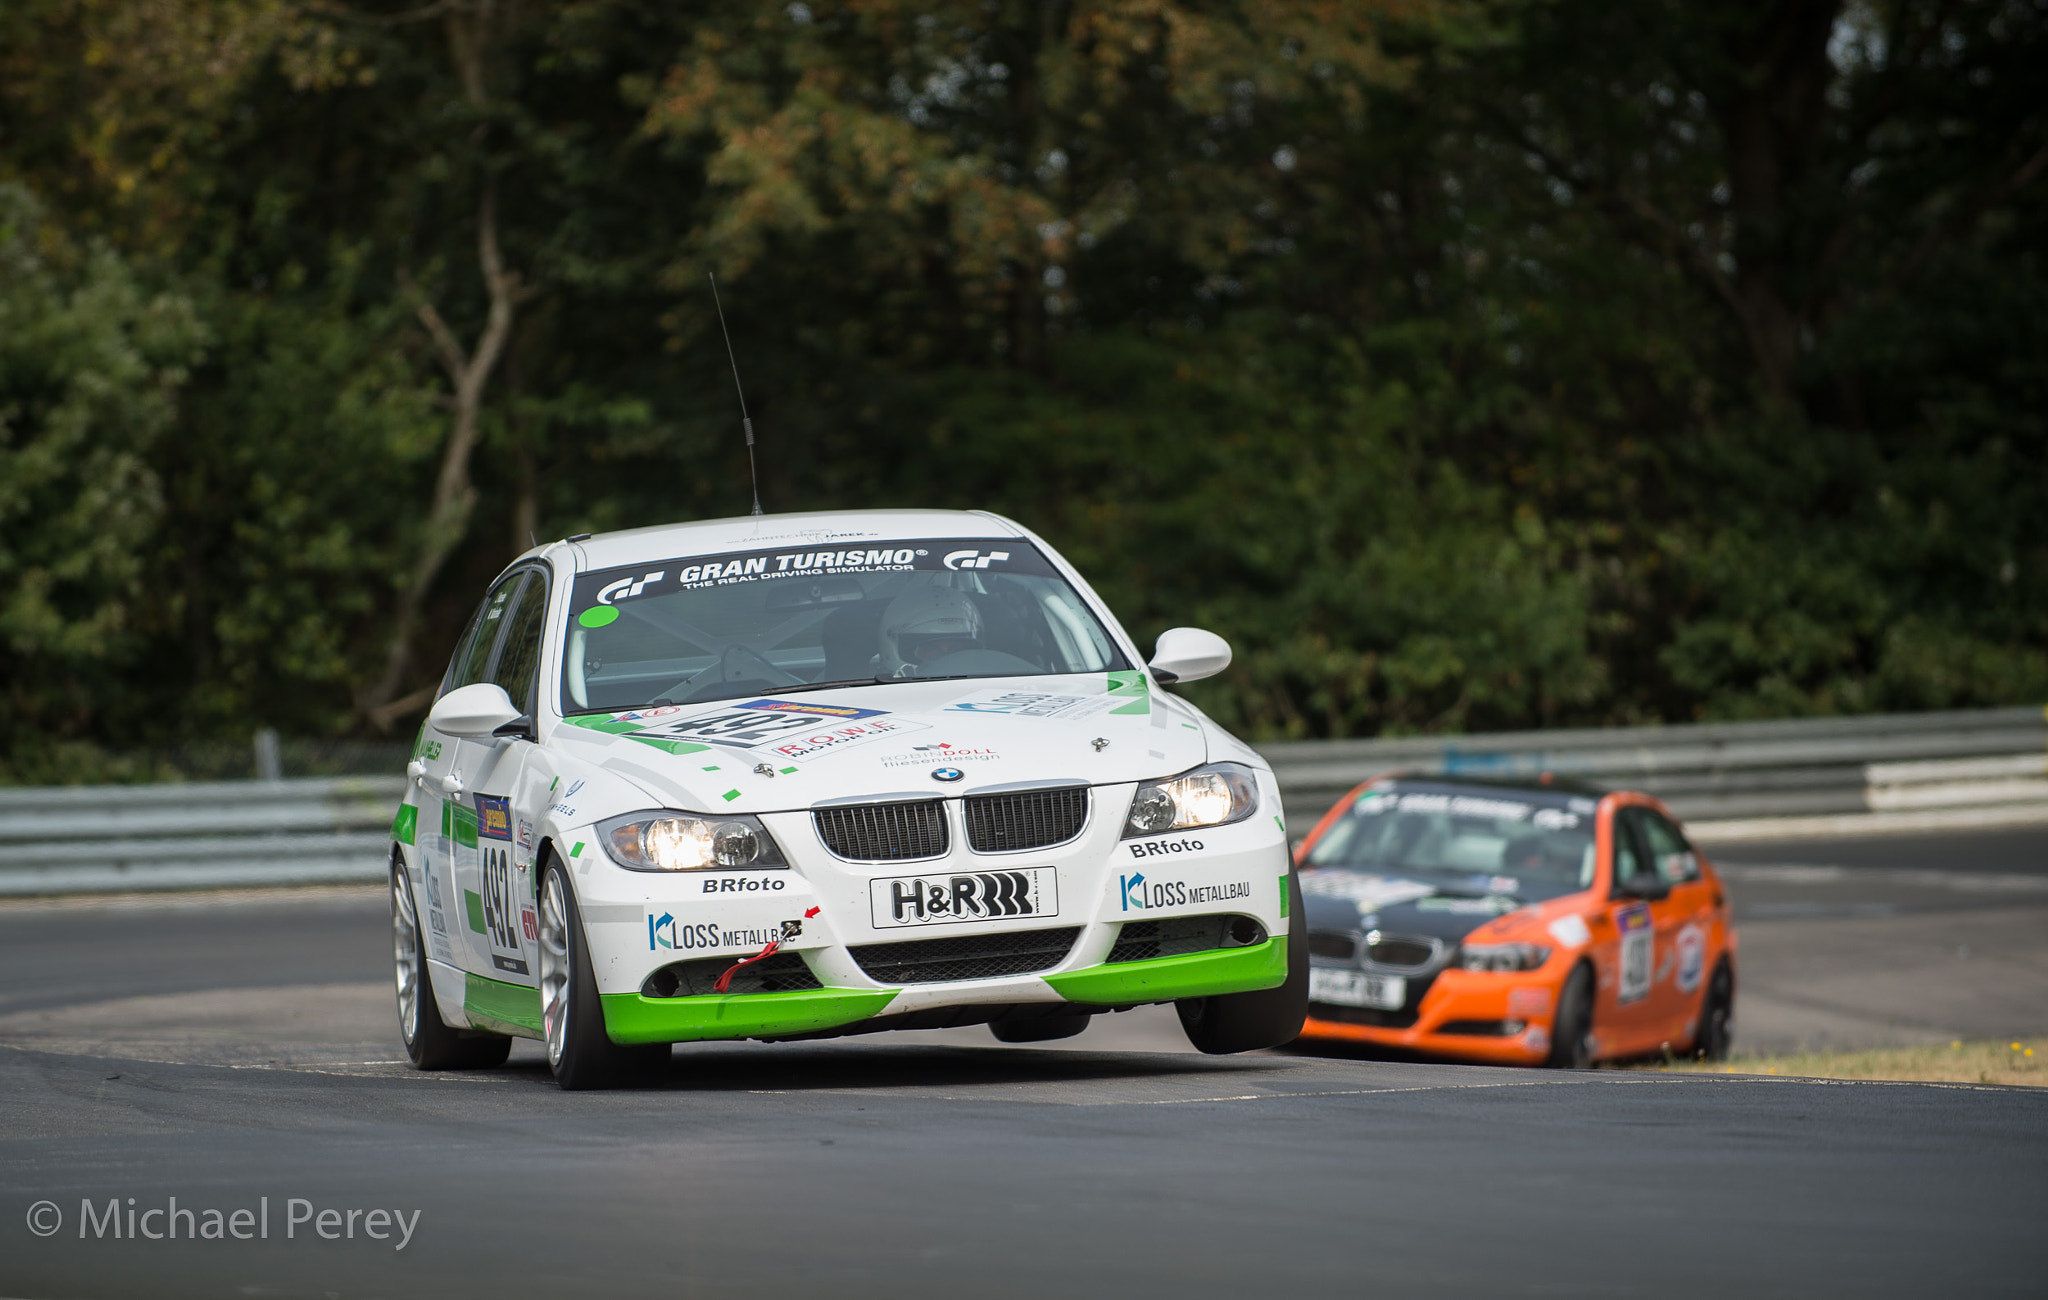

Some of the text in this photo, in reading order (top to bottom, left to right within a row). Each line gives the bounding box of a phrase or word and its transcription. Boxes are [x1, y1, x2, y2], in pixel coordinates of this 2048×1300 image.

[679, 557, 767, 584] GRAN
[683, 564, 914, 590] THE REAL DRIVING SIMULATOR
[669, 711, 823, 740] 492
[777, 720, 894, 755] ROWE
[790, 726, 898, 758] MOTOR OIL
[884, 754, 1000, 768] fliesendesign
[1129, 839, 1204, 858] BRfoto
[483, 847, 518, 949] 492
[702, 877, 785, 893] BRfoto
[892, 873, 986, 922] H&R
[1120, 872, 1250, 912] KLOSS METALLBAU
[648, 912, 797, 950] KLOSS METALLB
